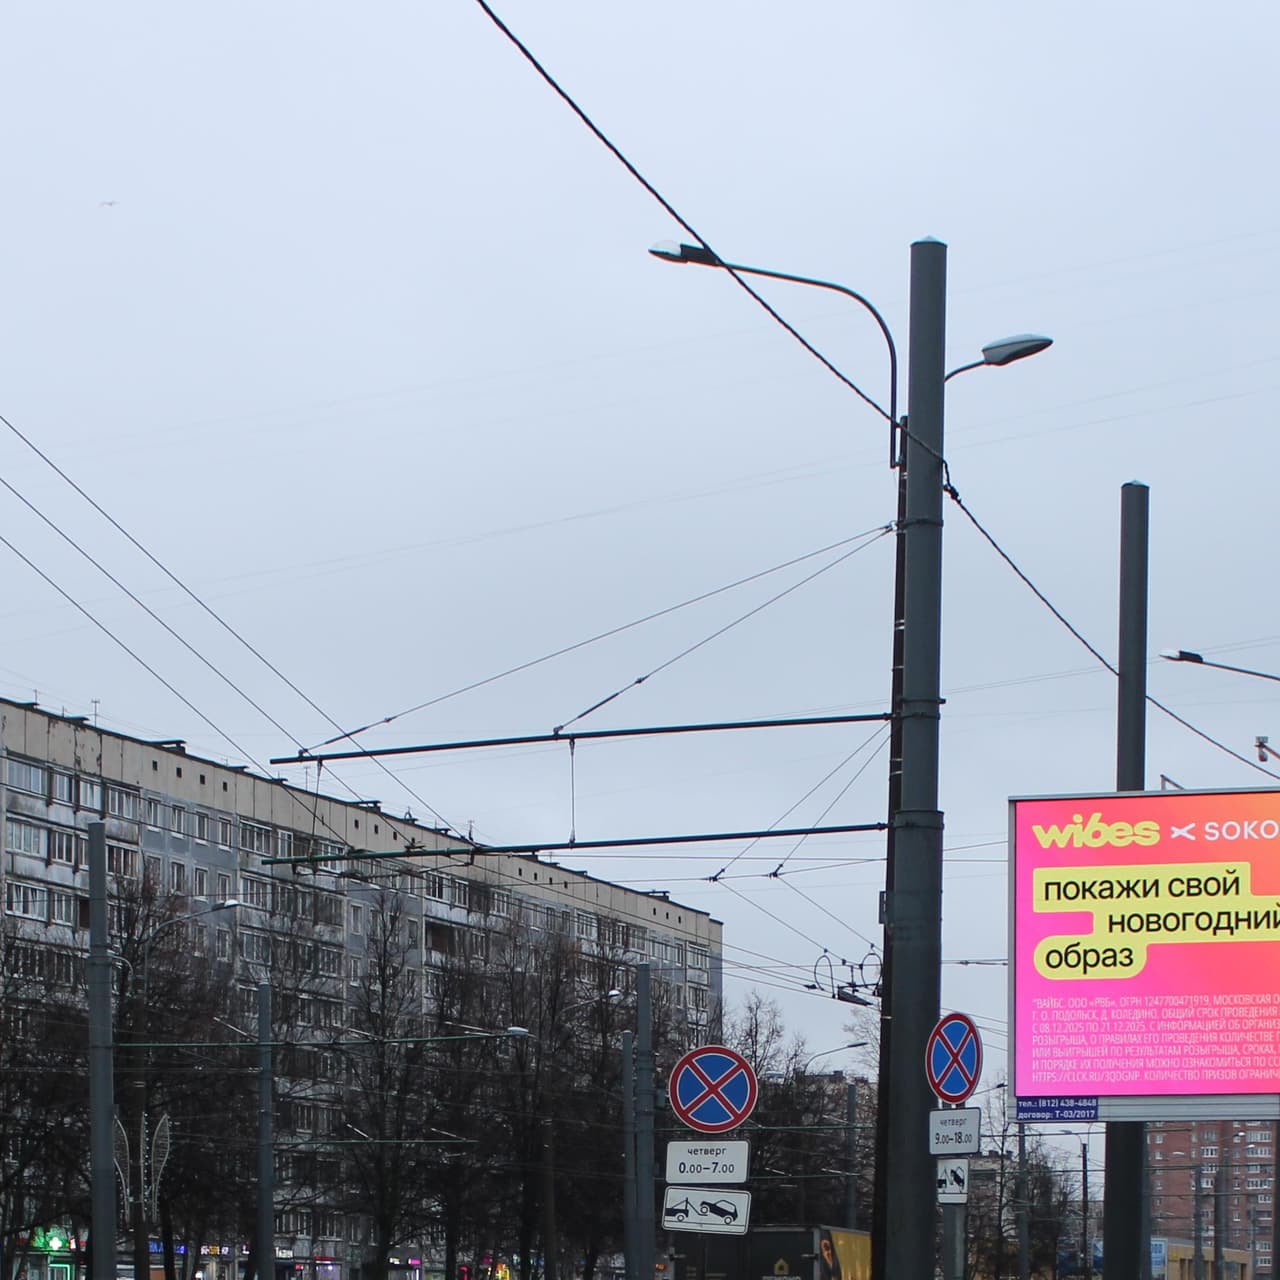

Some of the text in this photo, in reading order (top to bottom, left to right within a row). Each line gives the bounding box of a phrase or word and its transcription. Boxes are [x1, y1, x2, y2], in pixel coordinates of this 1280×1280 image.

[1044, 868, 1240, 901] покажи свой
[1045, 942, 1134, 974] образ
[1213, 993, 1271, 1005] МОСКОВСКАЯ
[1197, 1006, 1219, 1018] СРОК
[1220, 1006, 1278, 1019] ПРОВЕДЕНИЯ
[1086, 1021, 1099, 1033] ПО
[1228, 1018, 1240, 1031] ОБ
[1099, 1033, 1141, 1045] ПРАВИЛАХ
[1143, 1033, 1160, 1045] ЕГО
[1162, 1032, 1218, 1045] ПРОВЕДЕНИЯ
[1220, 1031, 1275, 1043] КОЛИЧЕСТВЕ
[1110, 1046, 1123, 1057] ПО
[1254, 1055, 1266, 1067] ПО
[1144, 1068, 1201, 1081] КОЛИЧЕСТВО
[1202, 1068, 1237, 1080] ПРИЗОВ
[1039, 1098, 1059, 1108] (812)
[935, 1131, 973, 1145] 9.00-18.00
[687, 1148, 727, 1157] четверг
